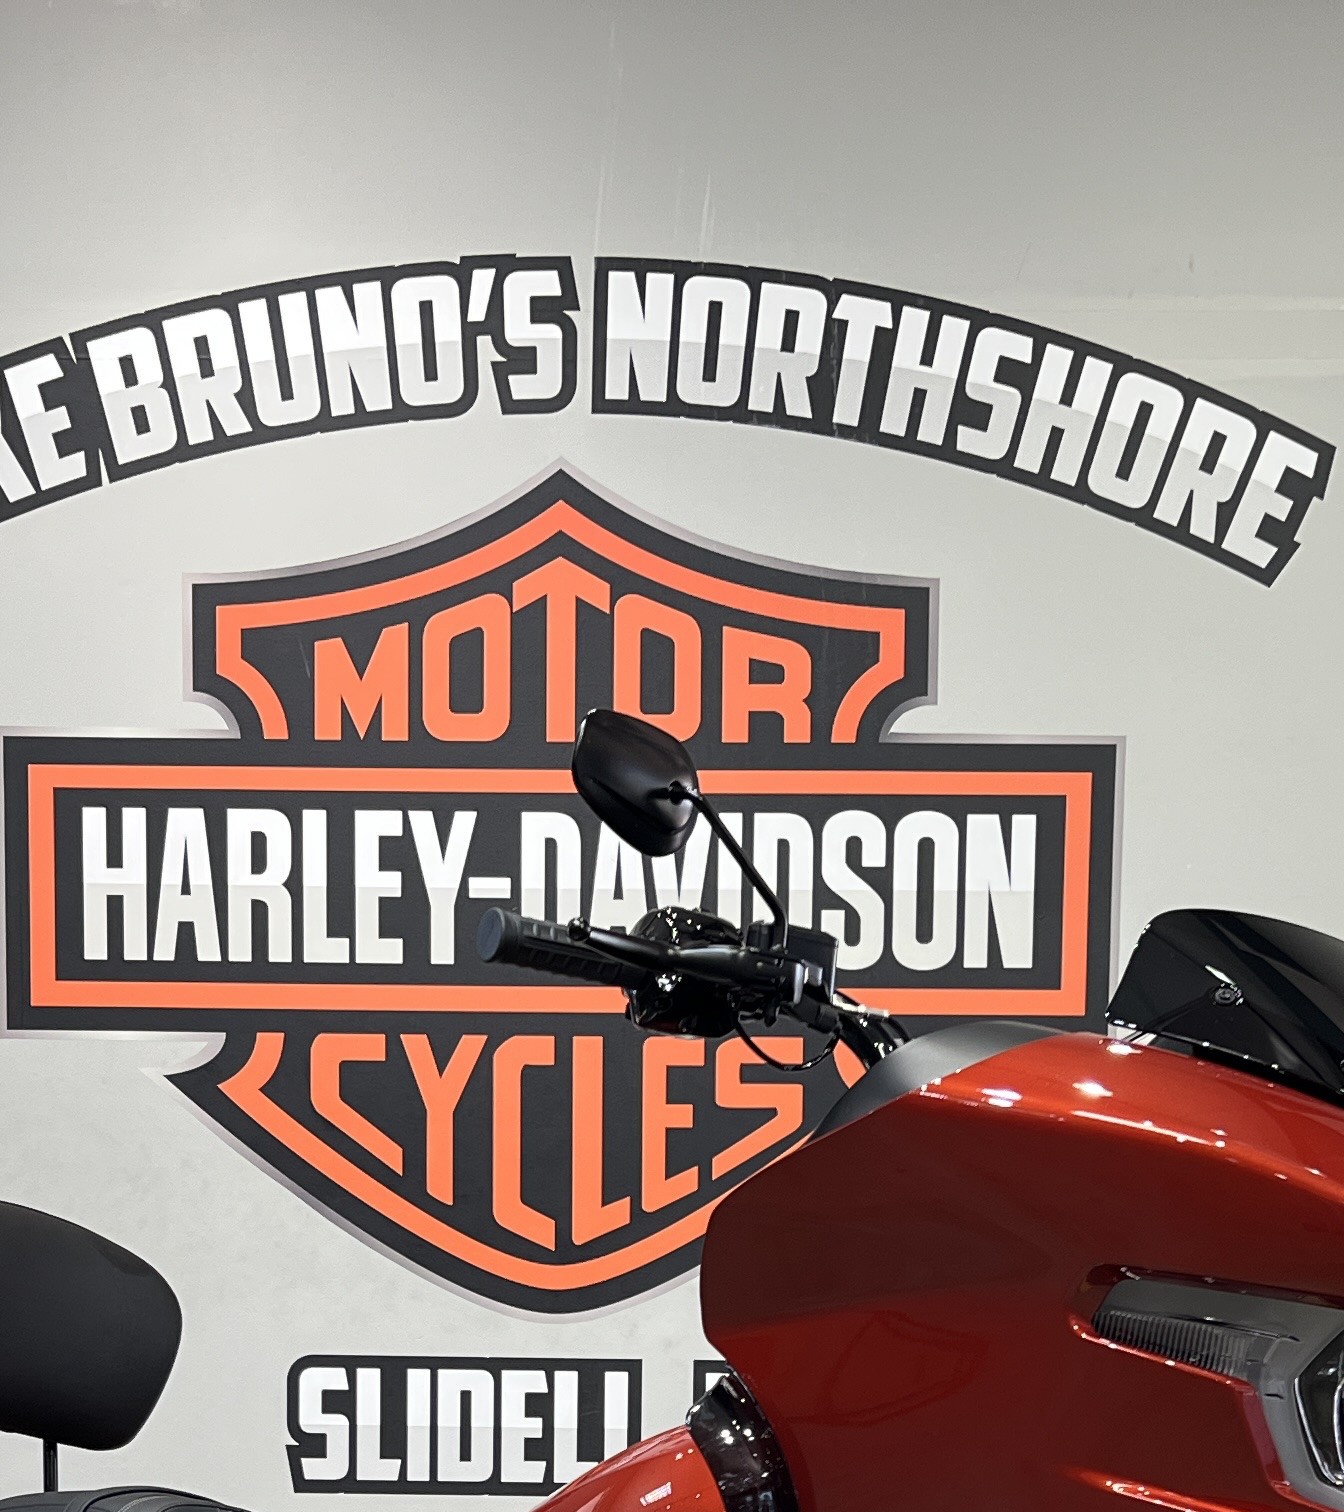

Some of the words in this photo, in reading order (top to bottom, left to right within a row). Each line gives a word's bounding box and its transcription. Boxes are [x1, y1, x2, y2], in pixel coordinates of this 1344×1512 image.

[85, 267, 564, 466] BRUNO'S
[603, 269, 1320, 570] NORTHSHORE
[313, 555, 814, 744] MOTOR
[309, 1032, 811, 1253] CYCLES
